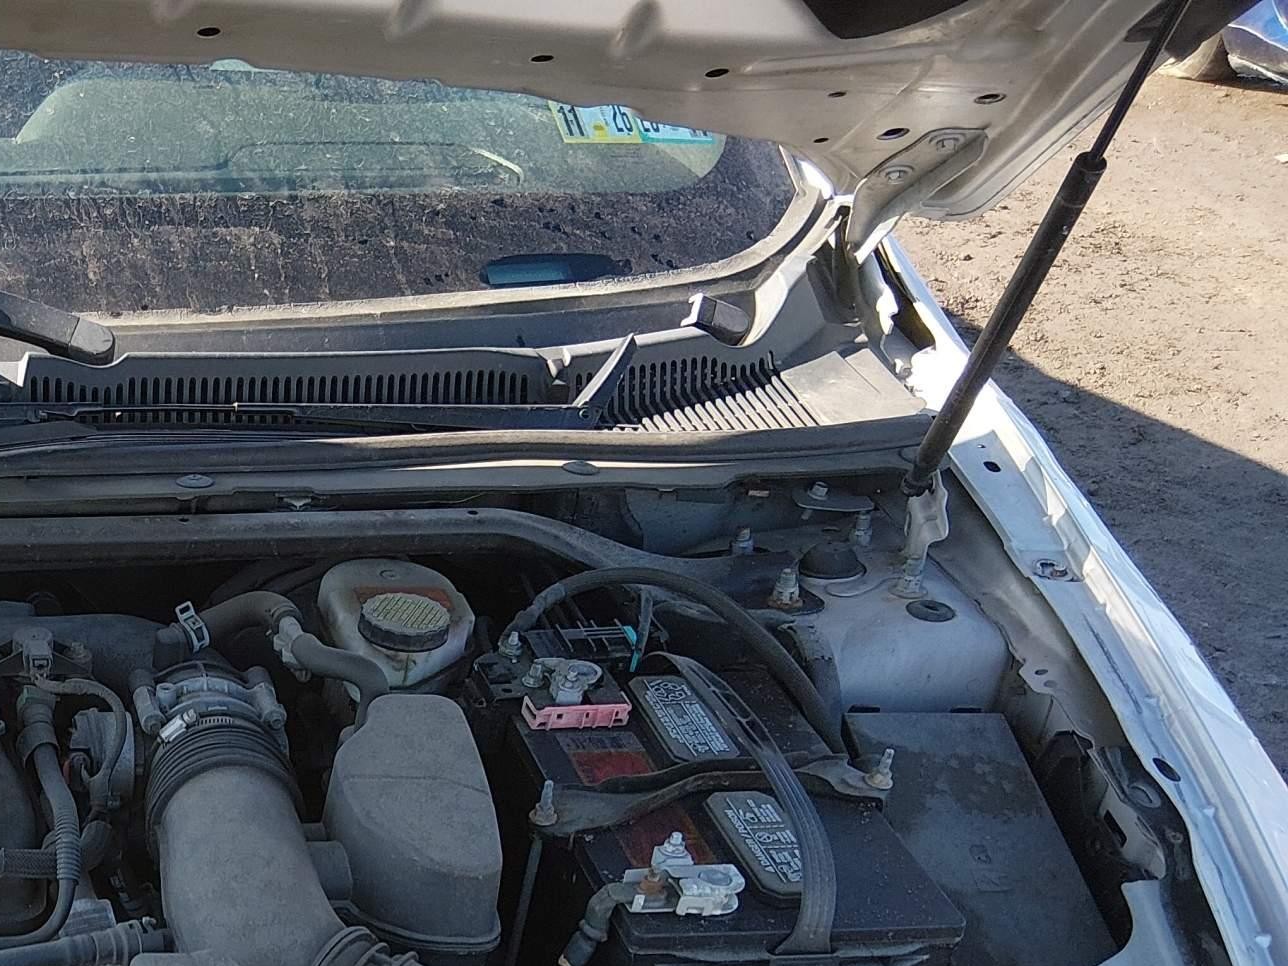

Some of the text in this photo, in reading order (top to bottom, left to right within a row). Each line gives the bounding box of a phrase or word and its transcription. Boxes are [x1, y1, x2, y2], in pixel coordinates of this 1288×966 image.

[558, 105, 585, 136] 11
[724, 809, 748, 834] POISON
[745, 840, 770, 866] DANGER
